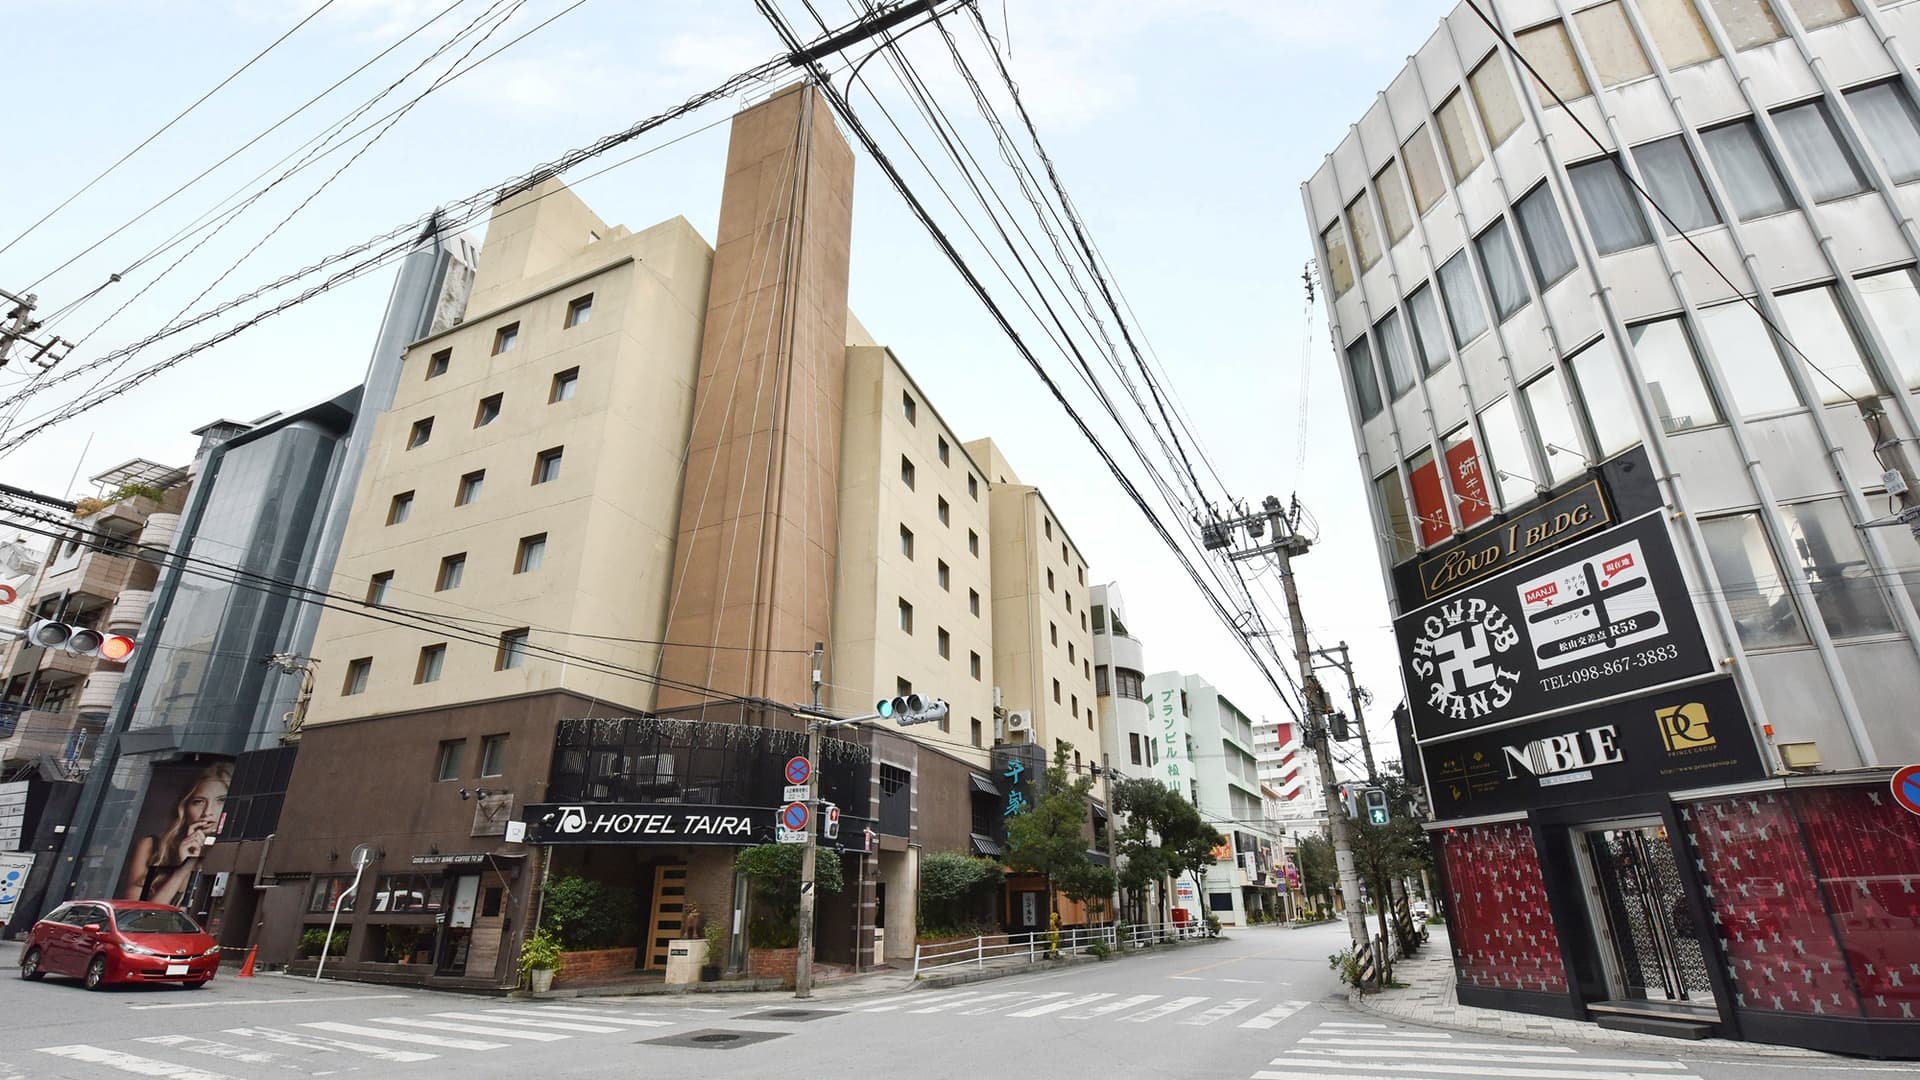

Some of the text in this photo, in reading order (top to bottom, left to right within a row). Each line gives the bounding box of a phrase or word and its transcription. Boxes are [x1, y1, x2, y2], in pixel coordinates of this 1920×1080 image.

[1506, 524, 1520, 556] I
[1526, 585, 1556, 602] MANJI
[1553, 612, 1580, 626] ローソン
[1558, 619, 1638, 652] 松山交差点 R58
[1161, 689, 1181, 792] プランビル松山
[592, 814, 676, 834] HOTEL
[683, 815, 752, 836] TAIRA
